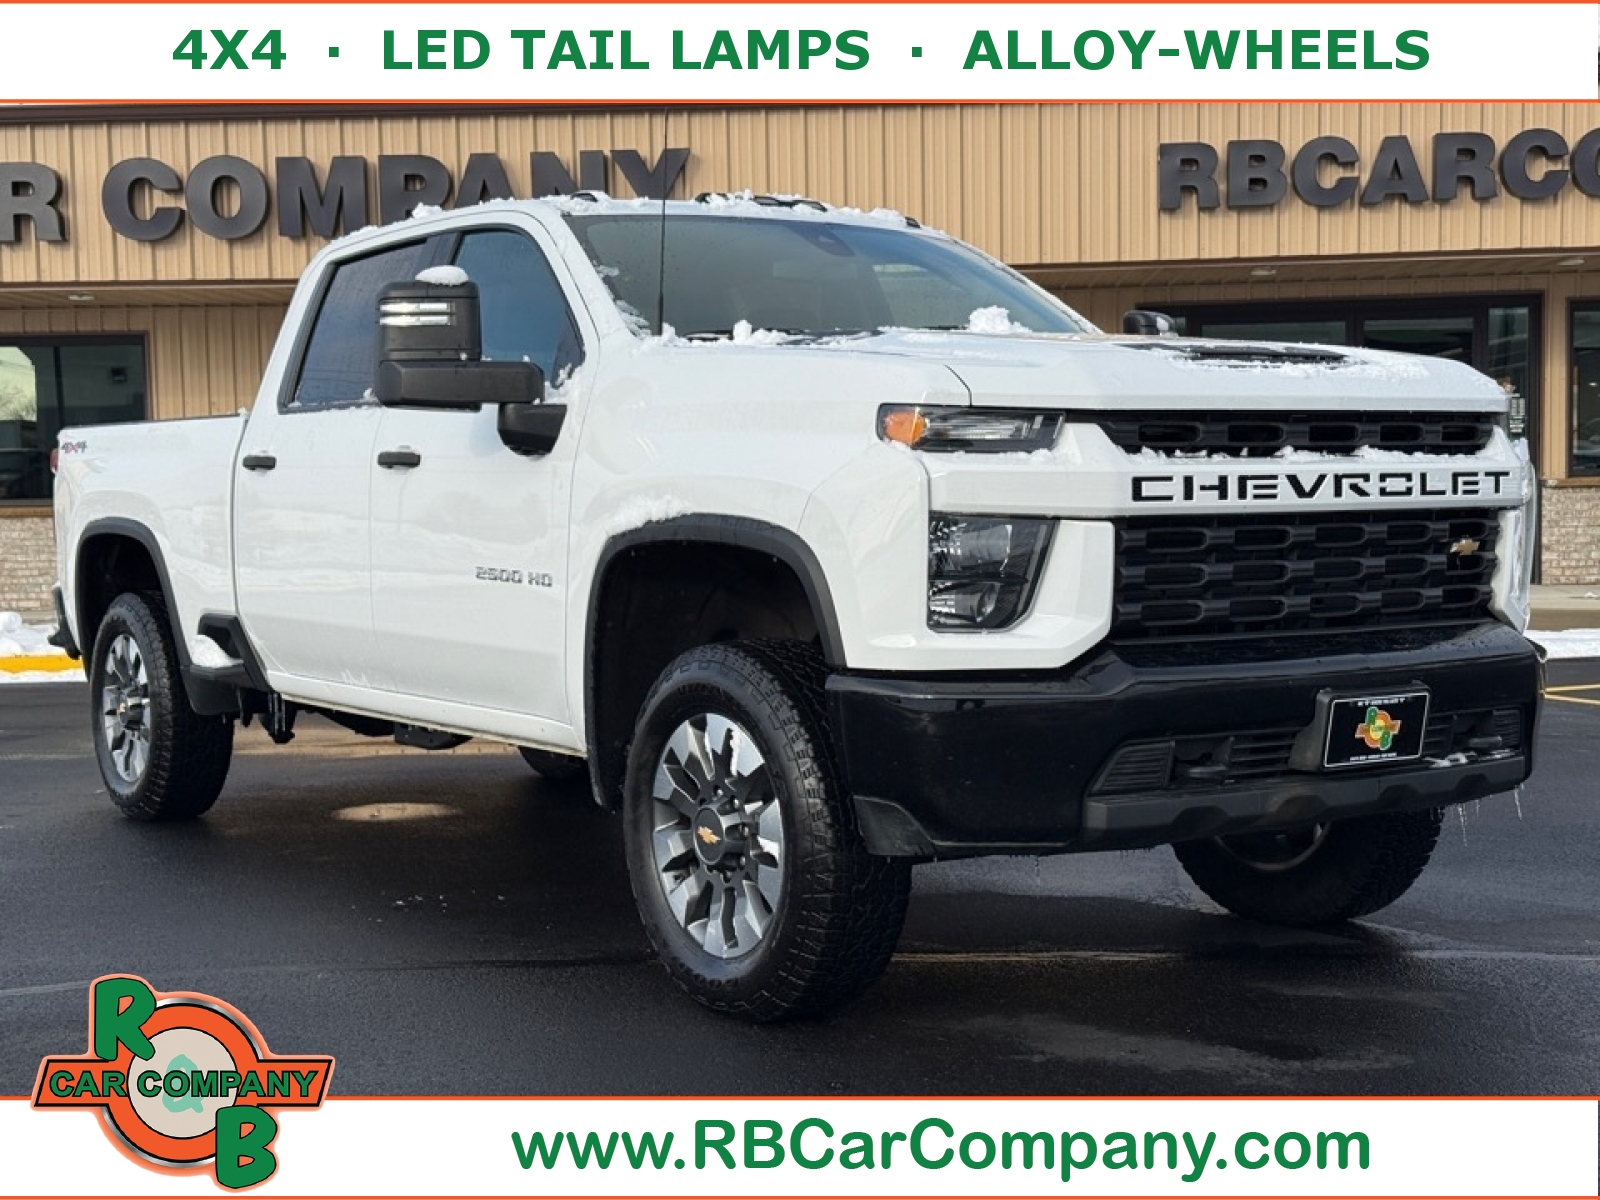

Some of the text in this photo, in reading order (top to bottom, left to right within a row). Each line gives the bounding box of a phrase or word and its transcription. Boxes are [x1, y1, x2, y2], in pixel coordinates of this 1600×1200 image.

[1131, 471, 1510, 502] CHEVROLET
[475, 566, 553, 587] 2500 HD
